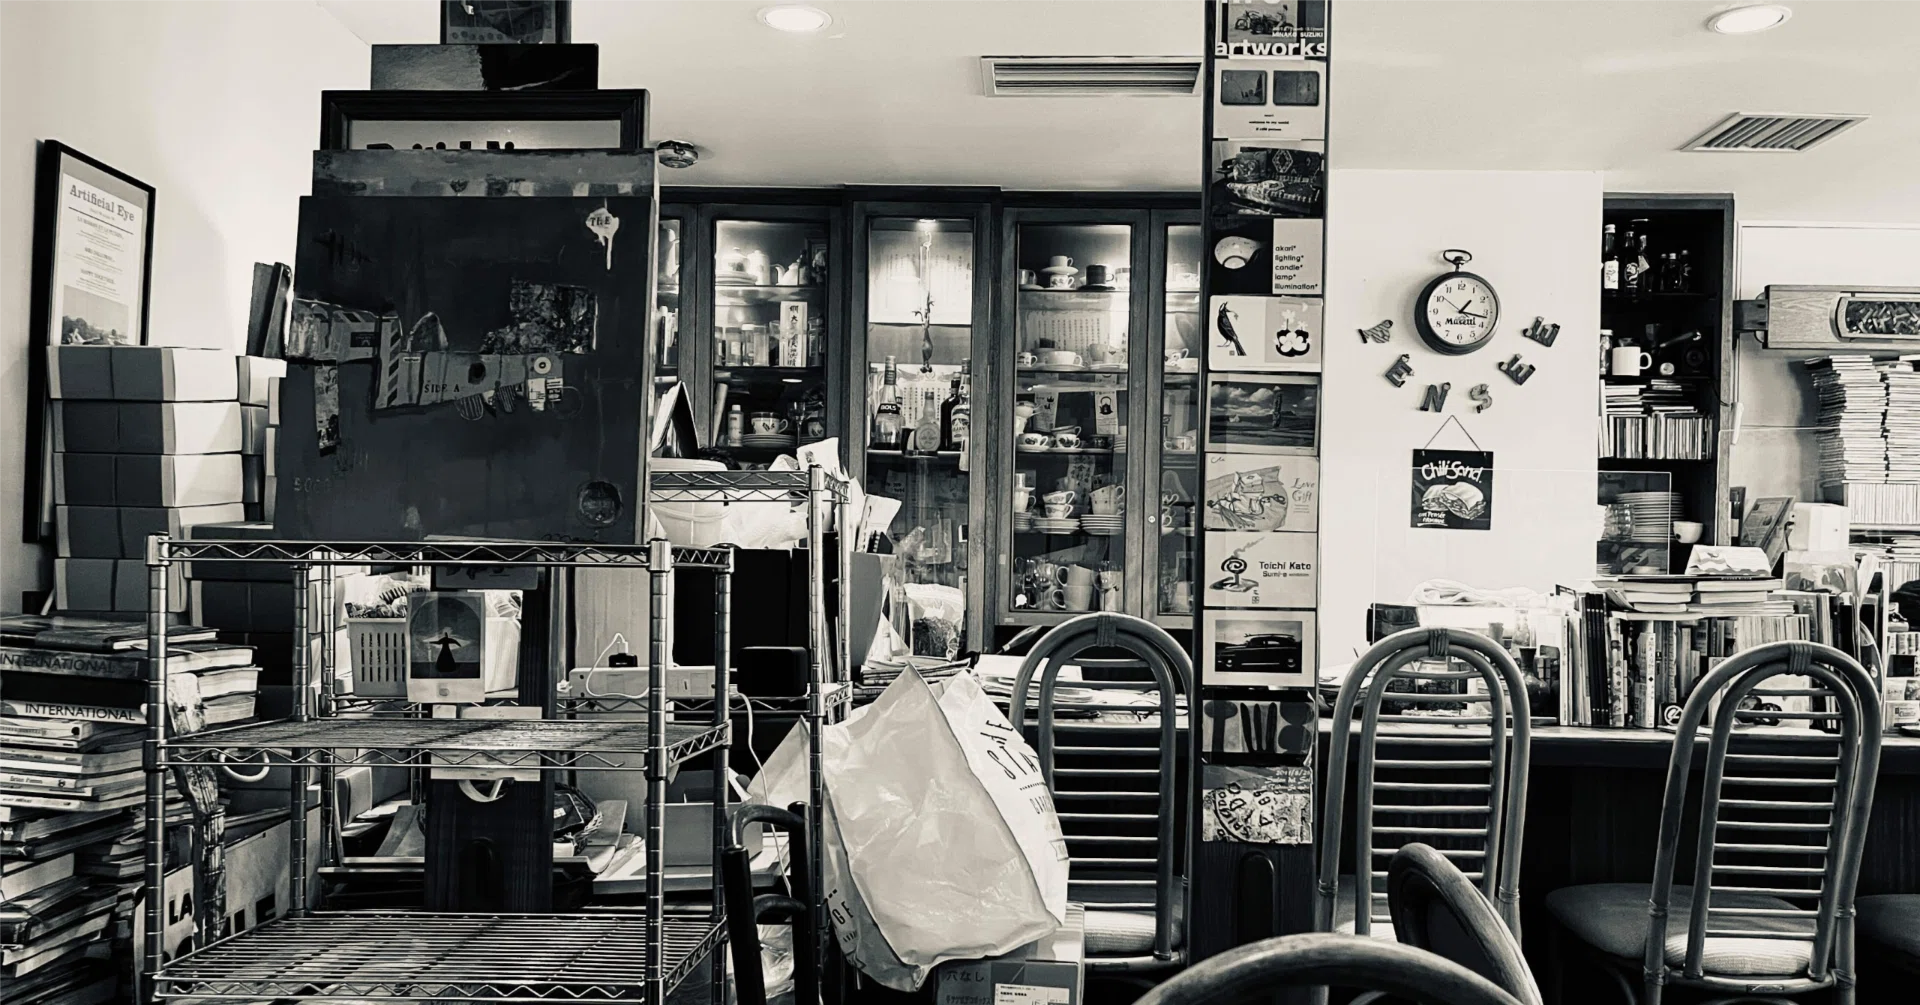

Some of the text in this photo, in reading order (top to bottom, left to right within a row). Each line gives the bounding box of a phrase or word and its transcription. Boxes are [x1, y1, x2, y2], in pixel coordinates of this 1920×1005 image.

[1215, 38, 1327, 56] artworks
[69, 184, 115, 213] Artificial
[116, 204, 135, 222] Eye
[1446, 286, 1452, 294] 11
[1457, 283, 1466, 291] 12
[1436, 295, 1445, 303] 10
[1479, 295, 1486, 303] 2
[1435, 320, 1442, 328] 8
[1478, 321, 1484, 329] 4
[1444, 329, 1450, 337] 7
[1456, 333, 1463, 341] 6
[1469, 330, 1476, 338] 5
[1421, 460, 1450, 480] Chili
[1290, 477, 1316, 490] Love
[1291, 489, 1313, 503] Gift
[1258, 561, 1312, 570] Toichi Kato
[0, 653, 115, 674] INTERNATIONAL
[25, 702, 136, 721] INTERNATIONAL
